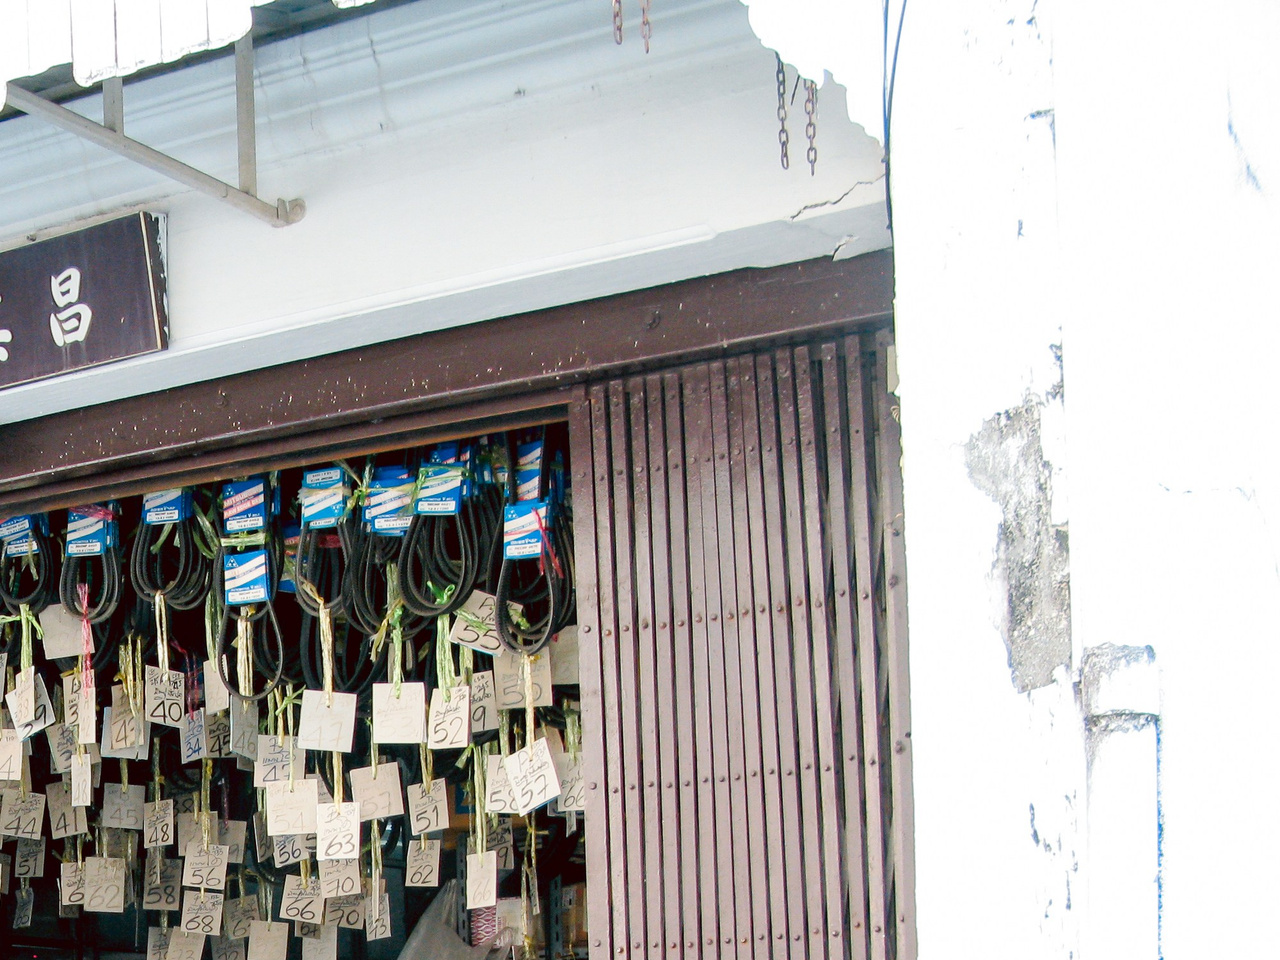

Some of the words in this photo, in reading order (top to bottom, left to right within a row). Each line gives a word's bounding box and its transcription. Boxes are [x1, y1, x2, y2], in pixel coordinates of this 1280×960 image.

[151, 701, 182, 723] 40
[433, 717, 463, 745] 52
[185, 738, 202, 759] 34
[519, 772, 548, 808] 57
[361, 792, 391, 816] 57
[5, 816, 37, 836] 44
[55, 808, 78, 834] 41
[110, 806, 138, 826] 45
[274, 811, 305, 833] 54
[415, 804, 439, 832] 51
[148, 822, 169, 845] 48
[278, 841, 302, 864] 56
[324, 833, 356, 857] 63
[18, 858, 37, 876] 51
[190, 868, 221, 887] 56
[410, 864, 432, 884] 62
[89, 884, 118, 910] 62
[147, 885, 176, 905] 58
[326, 876, 354, 896] 70
[472, 879, 491, 901] 66
[285, 899, 316, 920] 66
[329, 908, 360, 927] 70
[185, 914, 213, 934] 68
